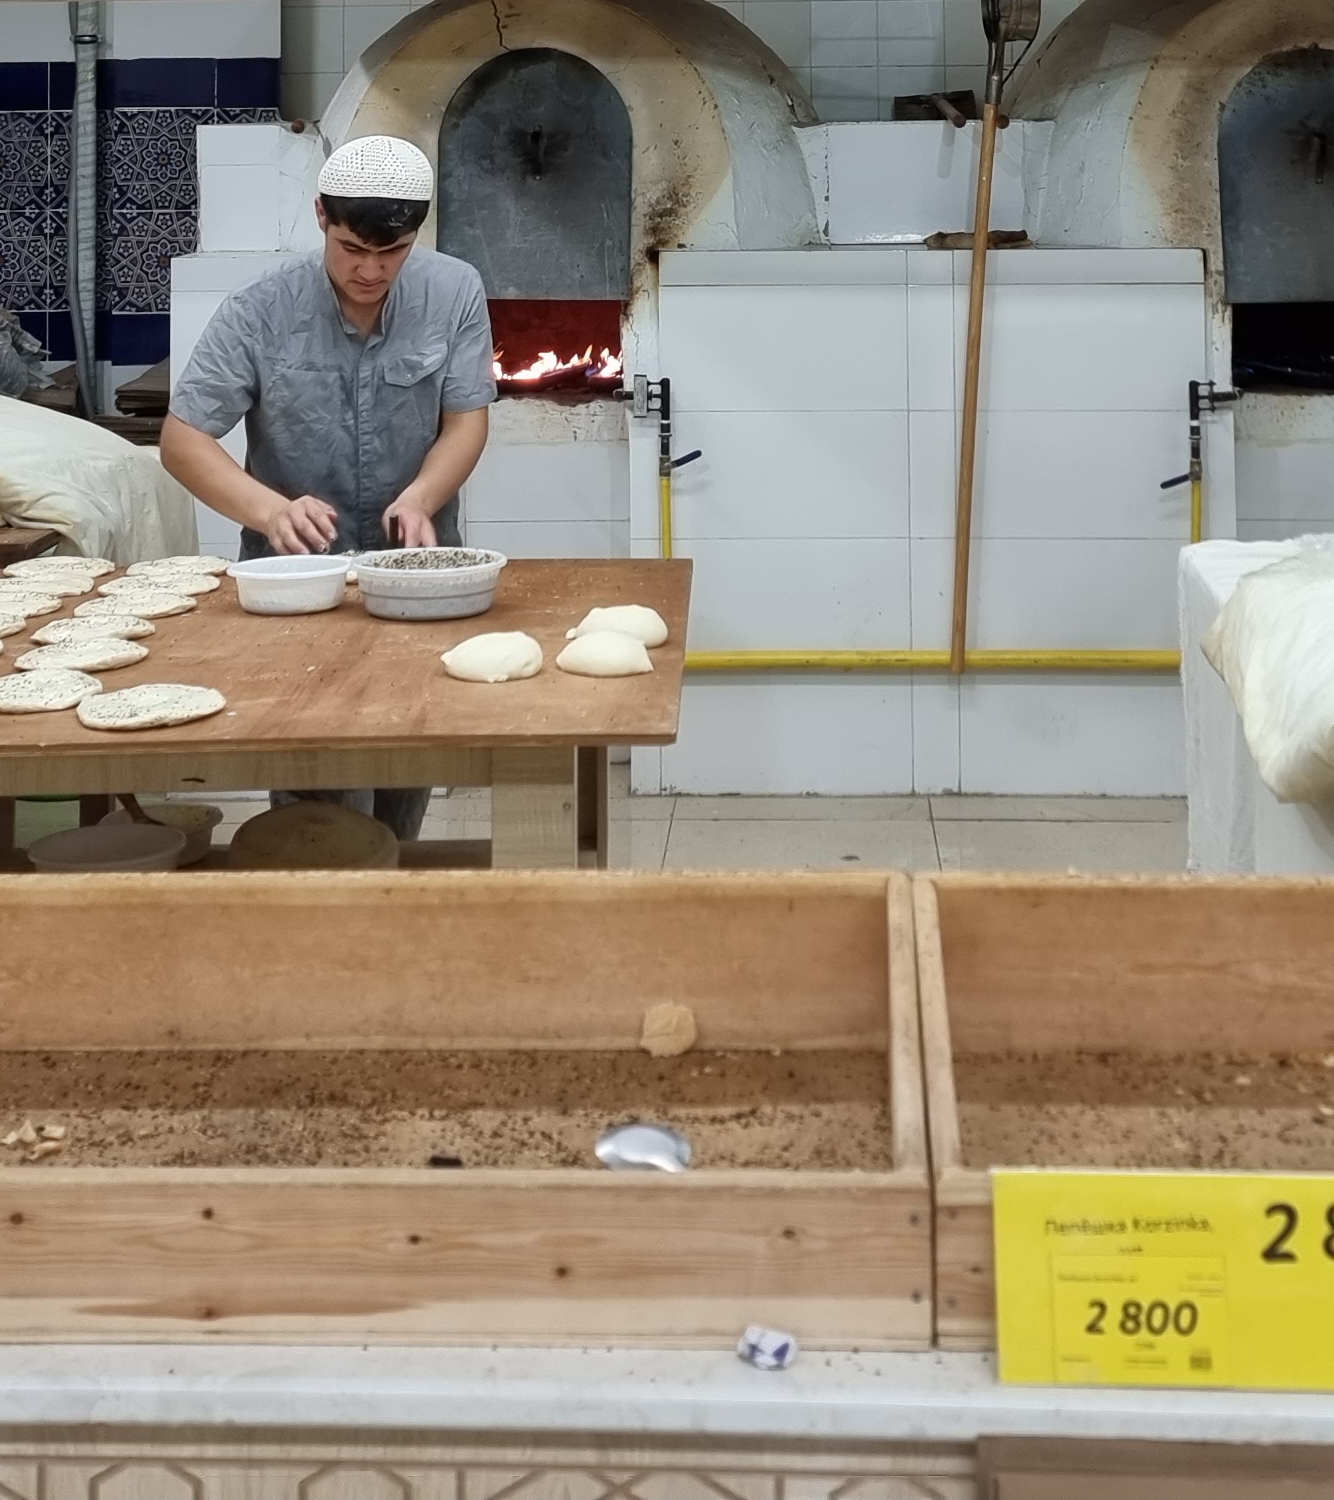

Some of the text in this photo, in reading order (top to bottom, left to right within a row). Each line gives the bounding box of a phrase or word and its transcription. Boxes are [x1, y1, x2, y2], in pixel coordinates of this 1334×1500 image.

[1260, 1201, 1300, 1265] 2
[1084, 1298, 1200, 1338] 2 800
